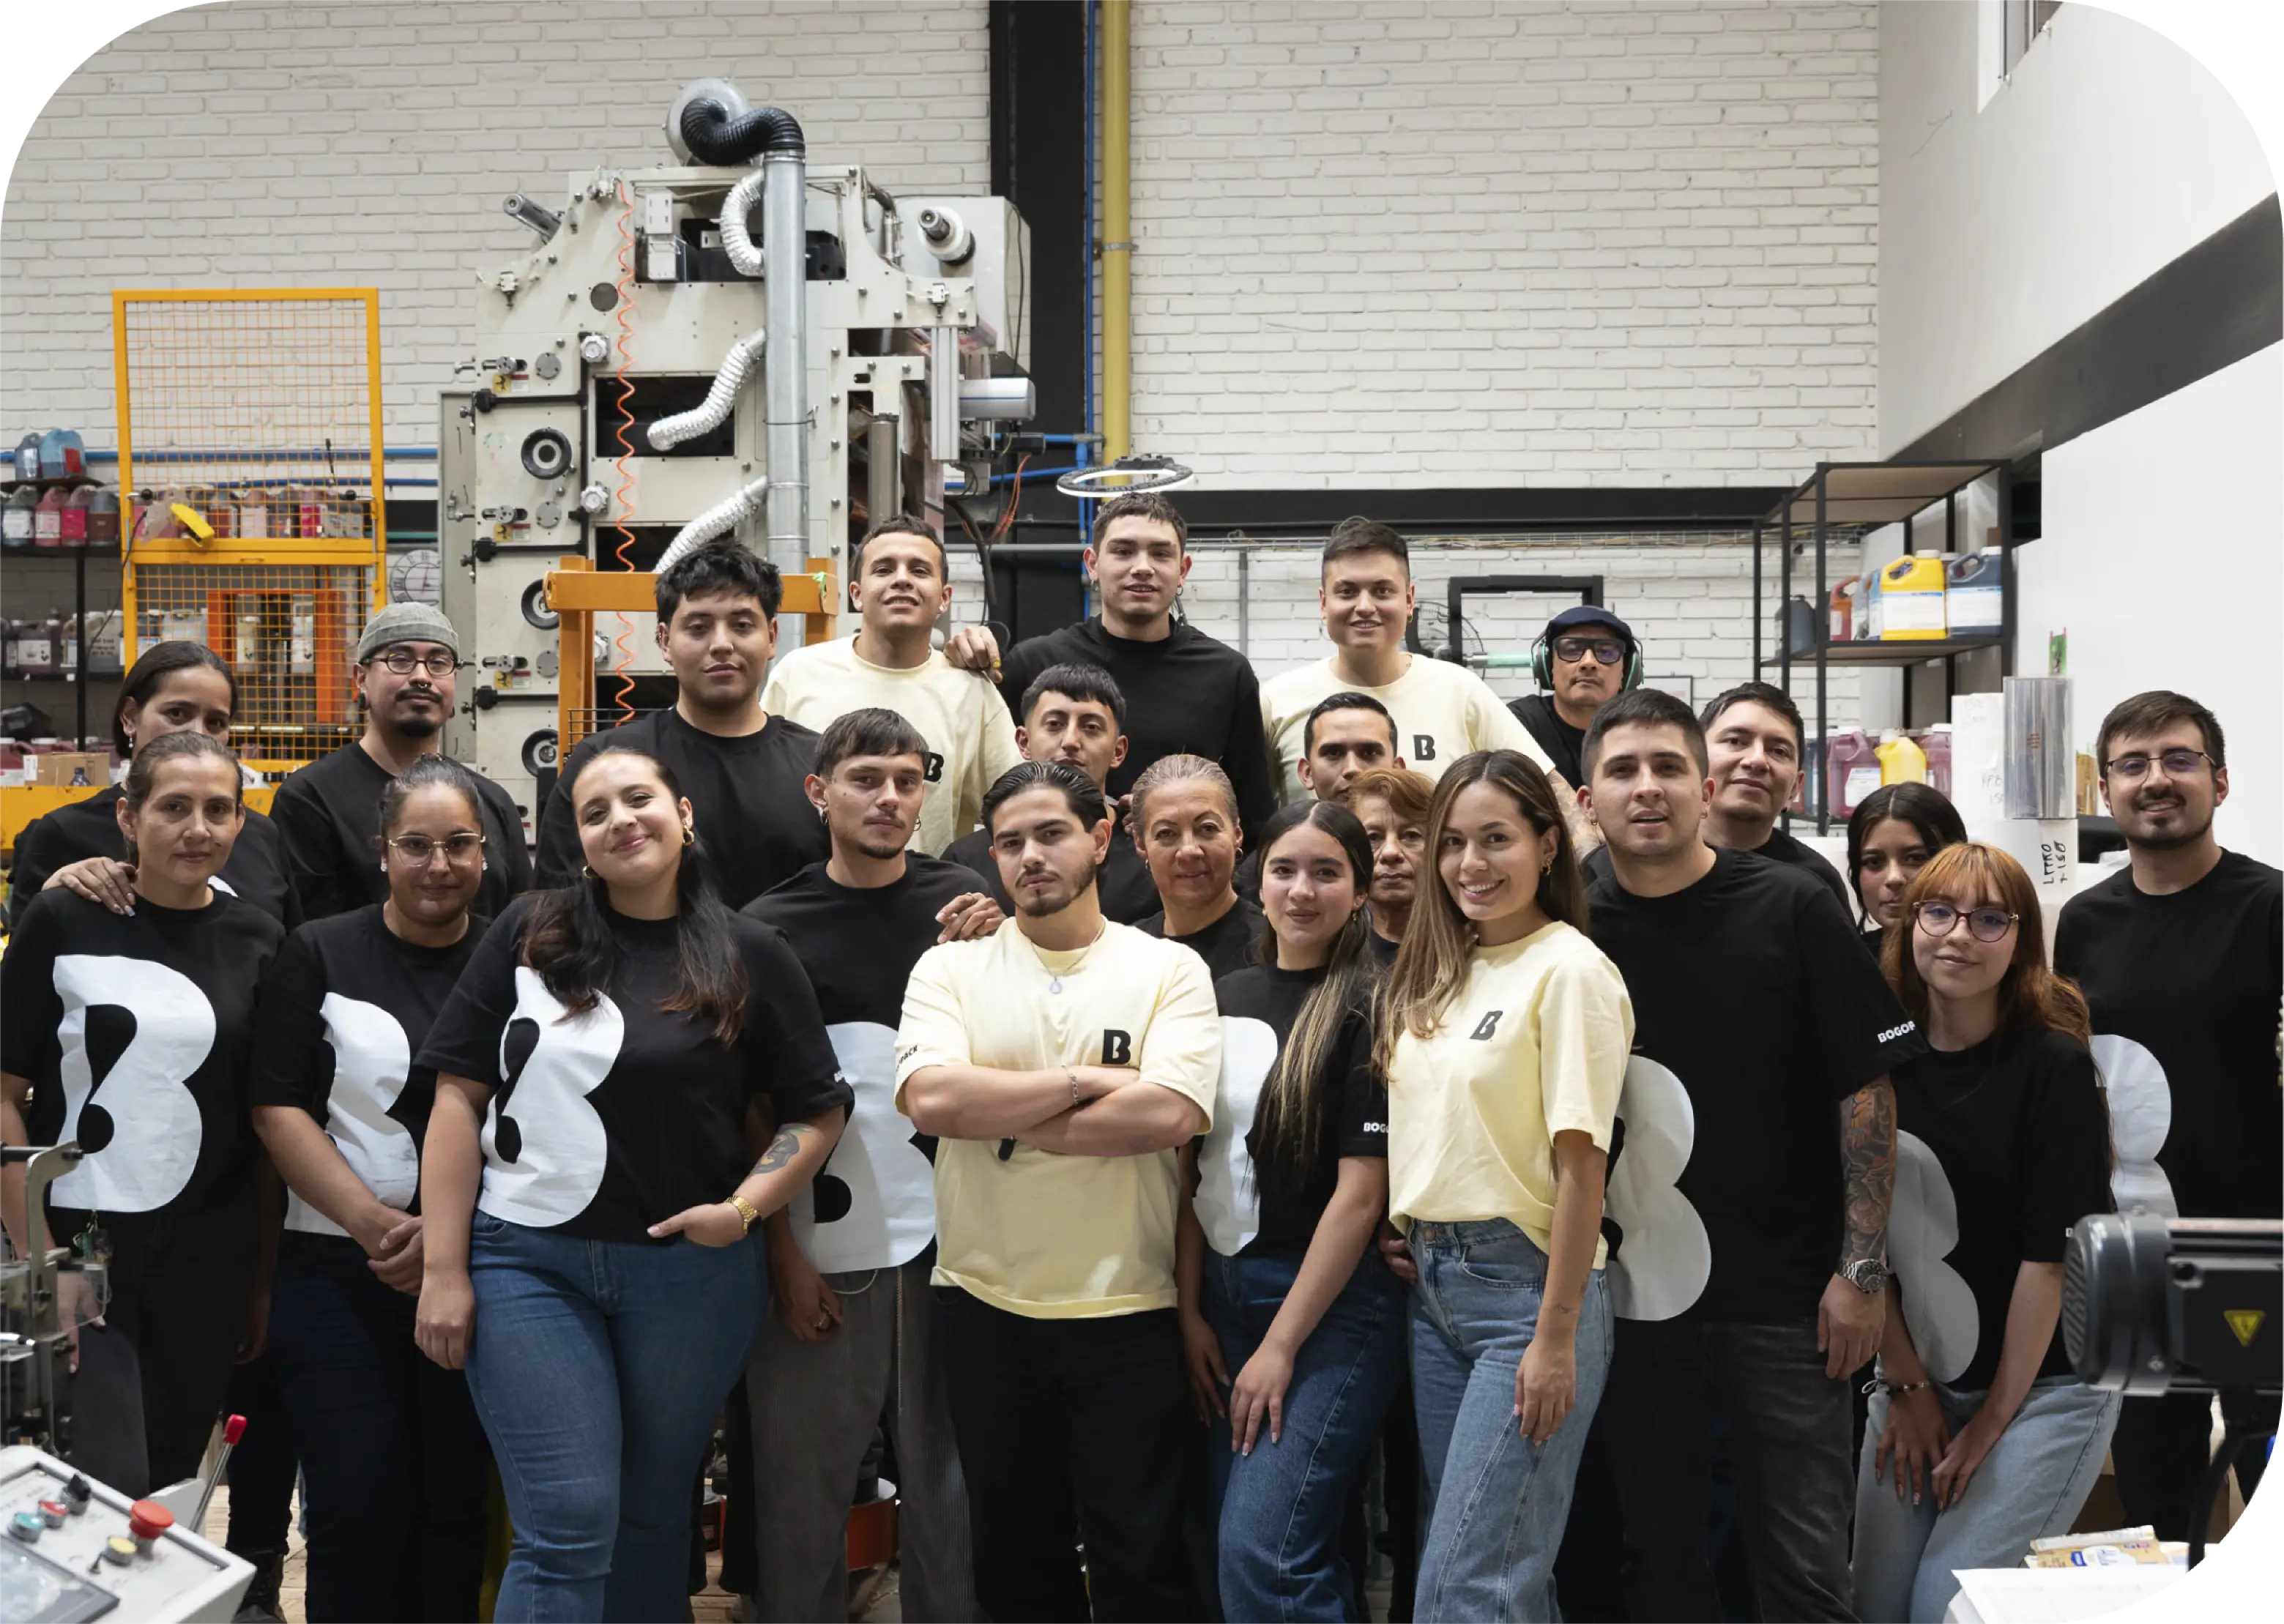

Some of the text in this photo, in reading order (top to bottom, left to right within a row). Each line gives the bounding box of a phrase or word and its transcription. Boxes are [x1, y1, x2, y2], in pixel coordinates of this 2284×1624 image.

[1413, 734, 1435, 761] B
[923, 752, 944, 782] B
[1470, 1010, 1503, 1040] B
[1101, 1029, 1131, 1065] B
[50, 953, 217, 1213] B
[477, 966, 625, 1227] B
